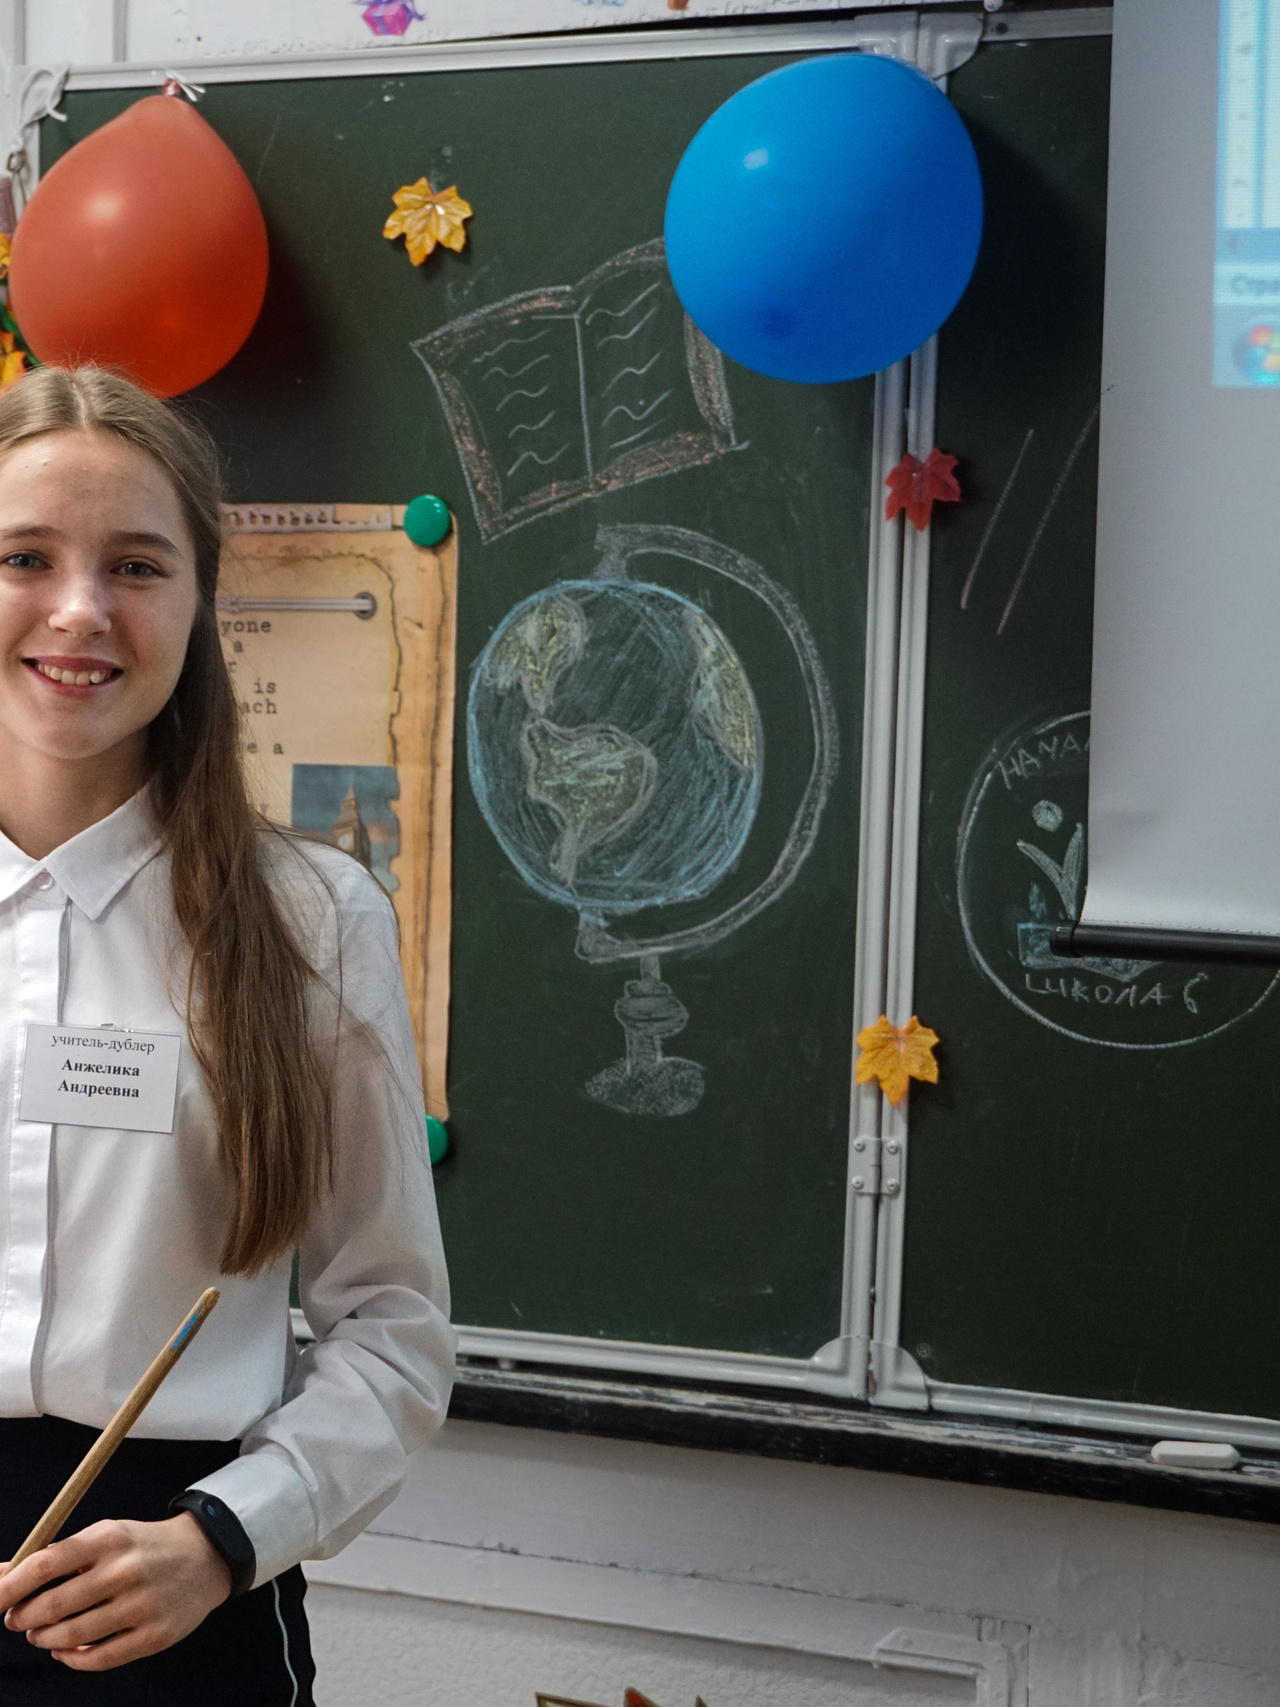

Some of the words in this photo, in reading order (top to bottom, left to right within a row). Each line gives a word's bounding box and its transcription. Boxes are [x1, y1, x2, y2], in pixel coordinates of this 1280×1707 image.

[253, 678, 276, 694] is
[240, 697, 277, 714] ach
[273, 741, 284, 754] a
[51, 1034, 155, 1055] учитель-дублер
[61, 1058, 140, 1077] Анжелика
[57, 1079, 140, 1098] Андреевна
